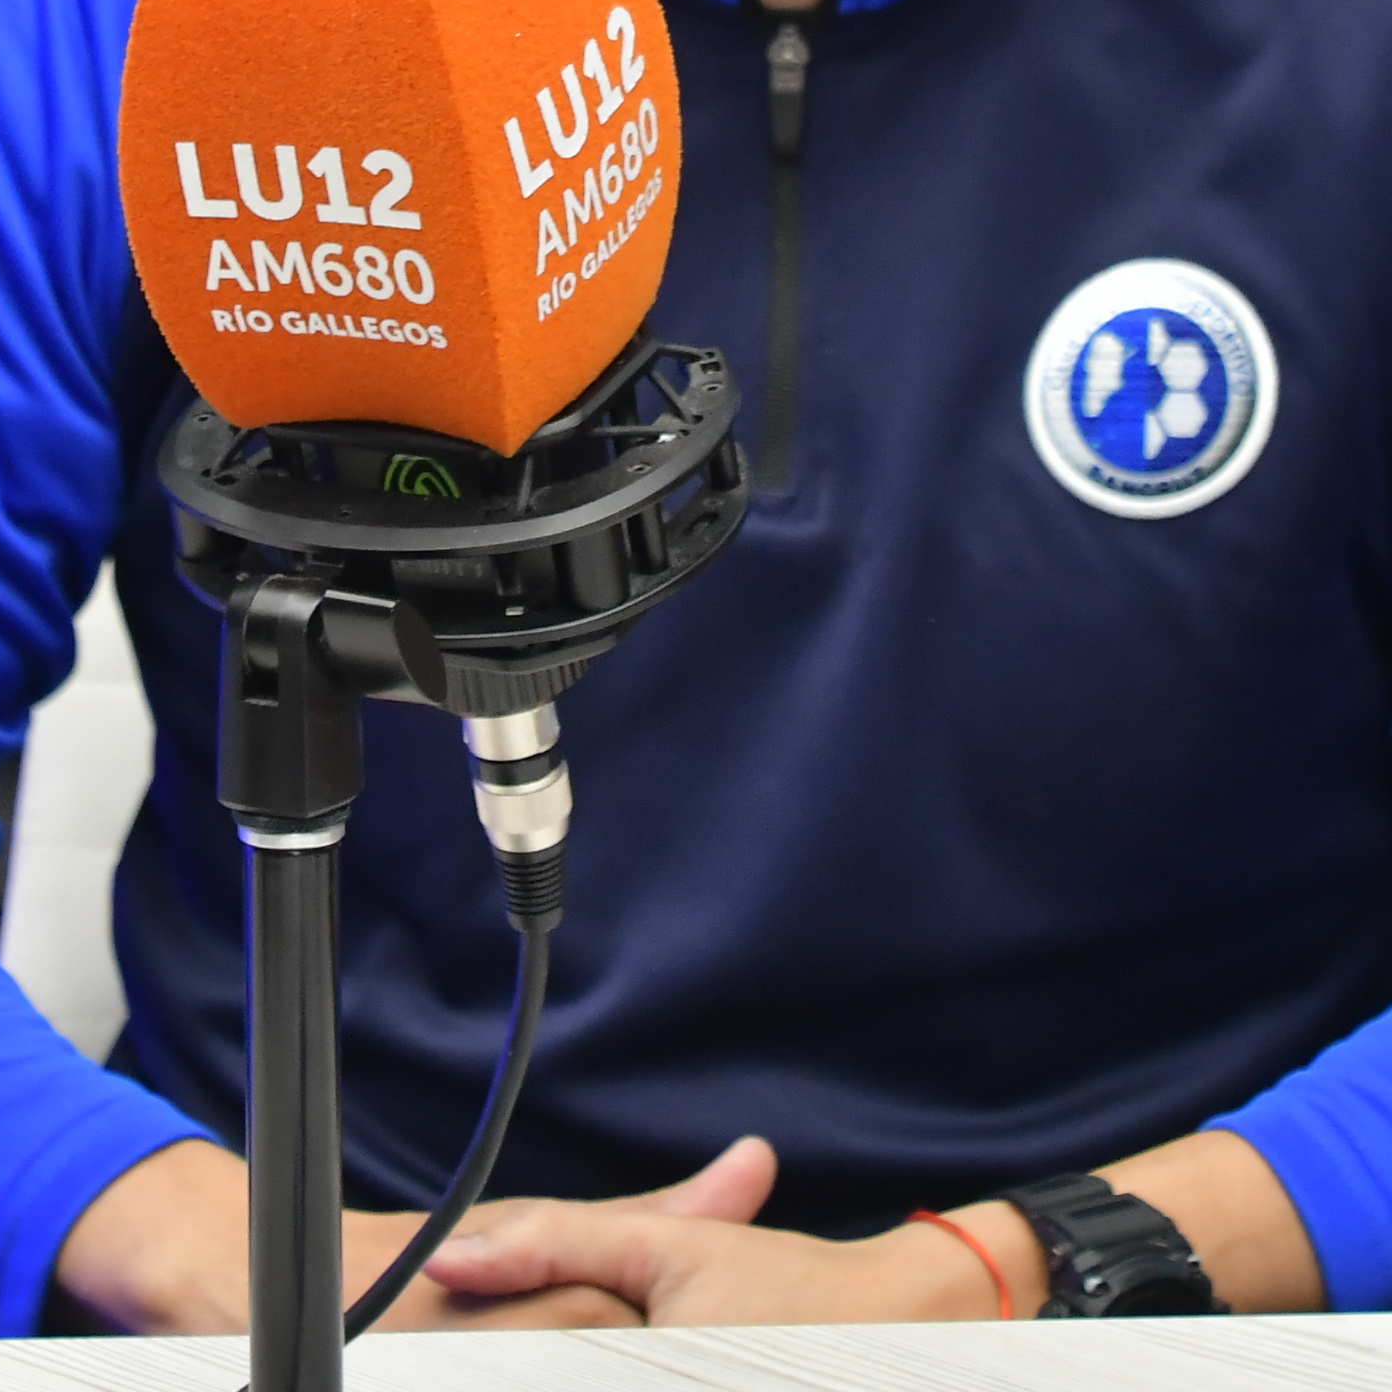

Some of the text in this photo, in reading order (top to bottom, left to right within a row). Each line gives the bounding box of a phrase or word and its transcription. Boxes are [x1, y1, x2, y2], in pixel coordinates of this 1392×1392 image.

[504, 5, 646, 199] LU12
[174, 141, 423, 231] LU12
[536, 97, 659, 276] AM680
[537, 166, 663, 322] RÍO GALLEGOS
[206, 238, 436, 306] AM680
[210, 304, 448, 349] RÍO GALLEGOS
